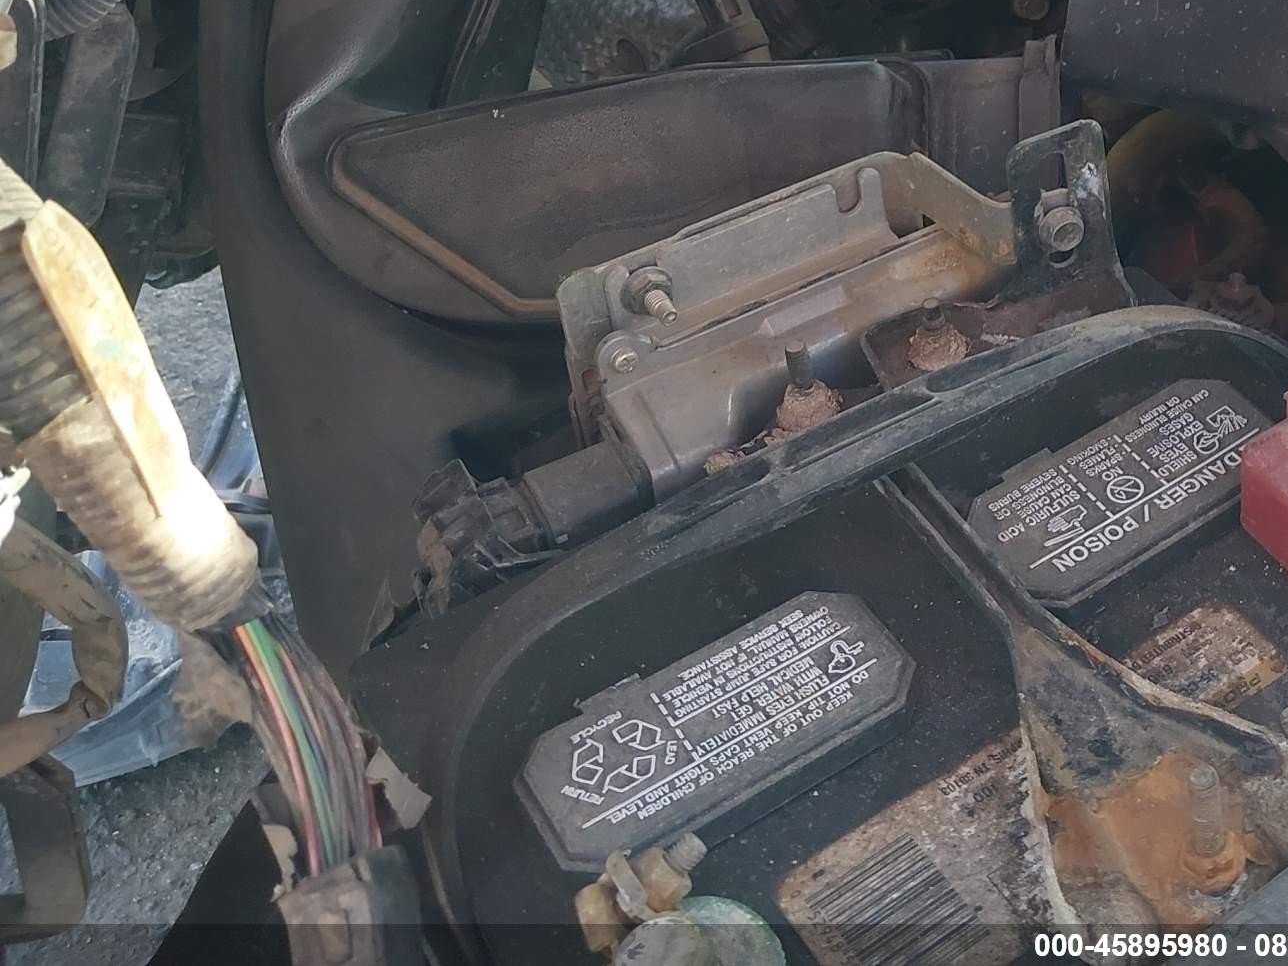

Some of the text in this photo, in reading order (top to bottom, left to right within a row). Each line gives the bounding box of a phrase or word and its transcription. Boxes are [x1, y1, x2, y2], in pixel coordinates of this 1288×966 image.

[1123, 387, 1209, 444] CAN CAUSE BLINDNESS
[1157, 409, 1194, 437] GASES
[1065, 436, 1109, 467] SMOKING
[1145, 417, 1204, 459] EXPLOSIVE
[1157, 439, 1189, 464] EYES
[1077, 444, 1115, 471] FLAMES
[1084, 451, 1122, 478] SPARKS
[1156, 447, 1198, 479] SHIELD
[1099, 463, 1124, 483] NO
[1151, 448, 1243, 512] DANGER
[986, 466, 1058, 513] SEVERE BURNS
[992, 473, 1065, 522] BLINDNESS OR
[1015, 481, 1072, 519] CAN CAUSE
[996, 487, 1081, 544] SULFURIC ACID
[1050, 511, 1139, 575] POISON
[777, 607, 804, 627] SEEK
[787, 604, 829, 632] OWNERS
[737, 621, 778, 649] SERVICE
[671, 614, 832, 708] FOLLOW INSTRUCTIONS IN VEHICLE
[673, 620, 841, 719] CAUTION: FOR SAFE JUMP STARTING
[712, 656, 735, 674] NOT
[792, 663, 822, 686] WITH
[661, 669, 712, 702] AVAILABLE
[709, 654, 814, 719] MEDICAL HELP FAST
[824, 679, 850, 699] NOT
[849, 668, 869, 685] DO
[693, 672, 830, 756] FLUSH EYES IMMEDIATELY
[728, 701, 753, 722] GET
[772, 706, 802, 729] KEEP
[568, 708, 622, 744] RECYCLE
[741, 724, 772, 747] VENT
[636, 689, 854, 821] KEEP OUT OF THE REACH OF CHILDREN
[664, 740, 676, 764] LEAD
[708, 742, 741, 766] CAPS
[671, 761, 708, 787] TIGHT
[560, 785, 605, 805] RETURN
[643, 782, 671, 804] AND
[605, 798, 644, 826] LEVEL
